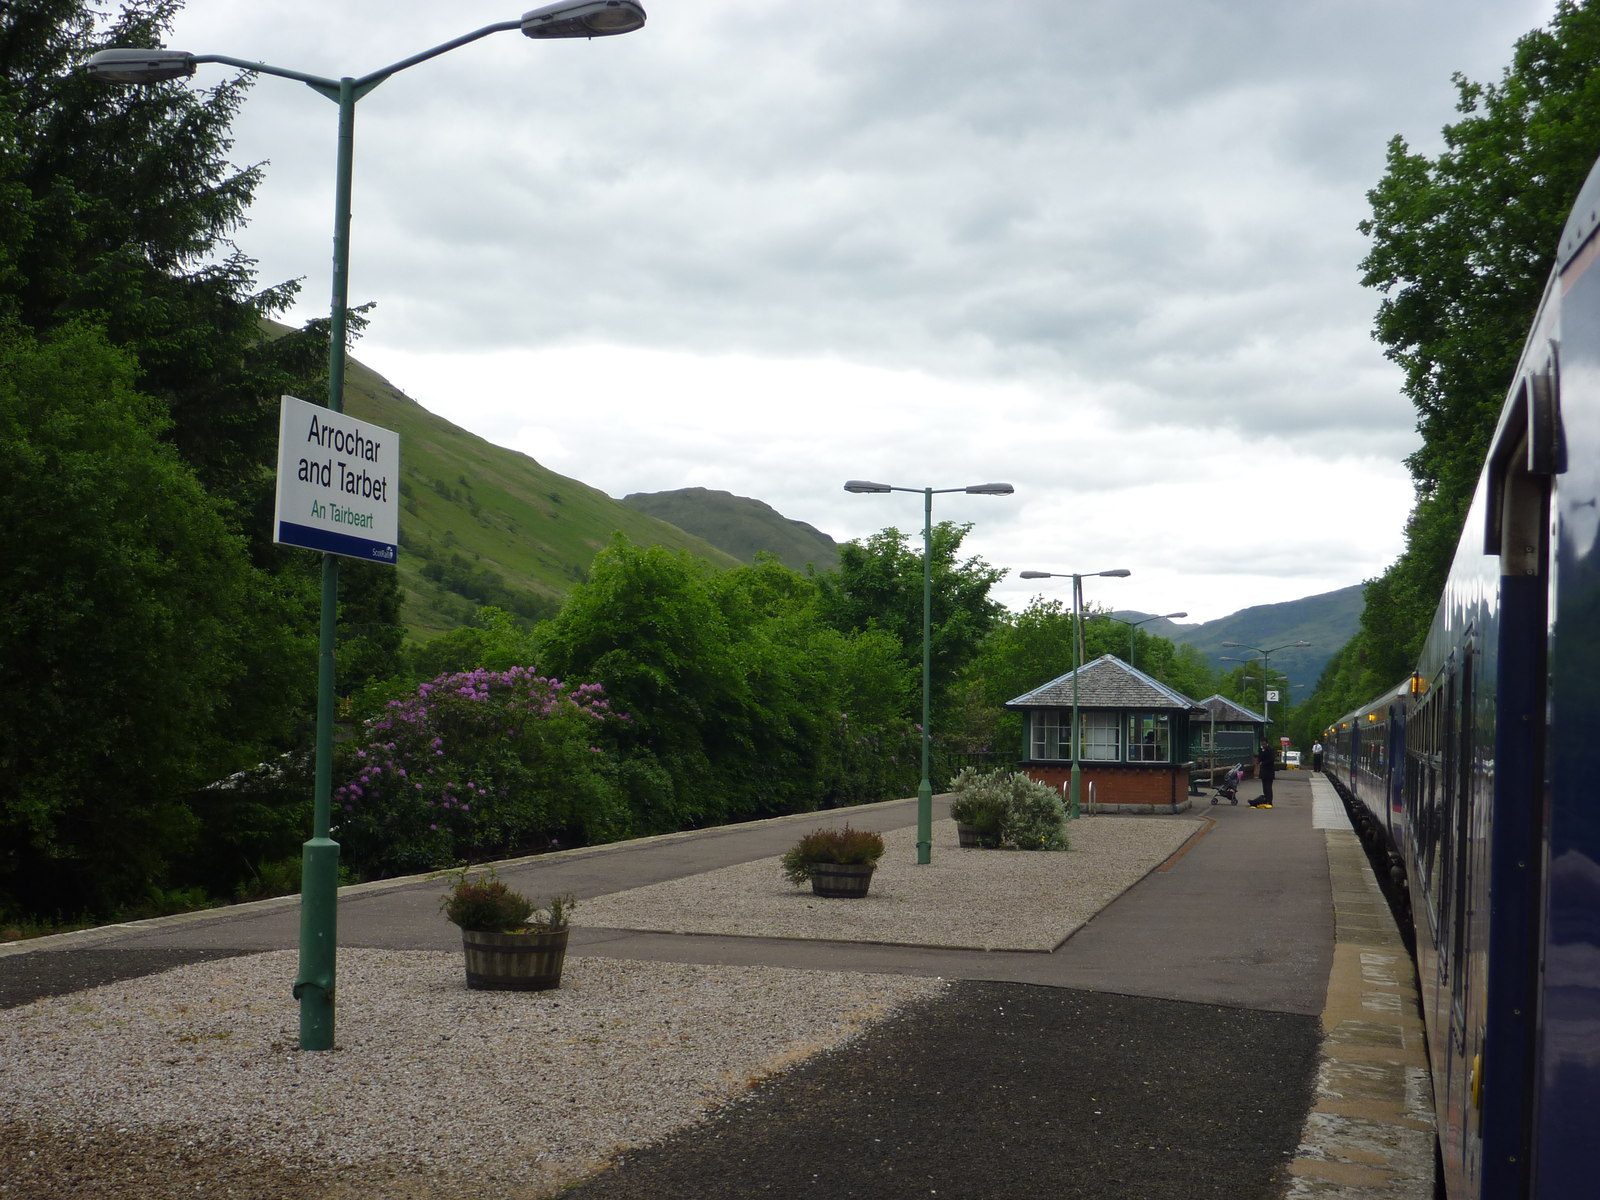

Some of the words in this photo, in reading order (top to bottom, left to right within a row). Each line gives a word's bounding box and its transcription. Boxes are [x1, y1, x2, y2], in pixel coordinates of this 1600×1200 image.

[308, 415, 380, 462] Arrochar
[298, 458, 331, 487] and
[338, 462, 386, 502] Tarbet
[311, 500, 326, 519] An
[329, 503, 373, 528] Tairbeart
